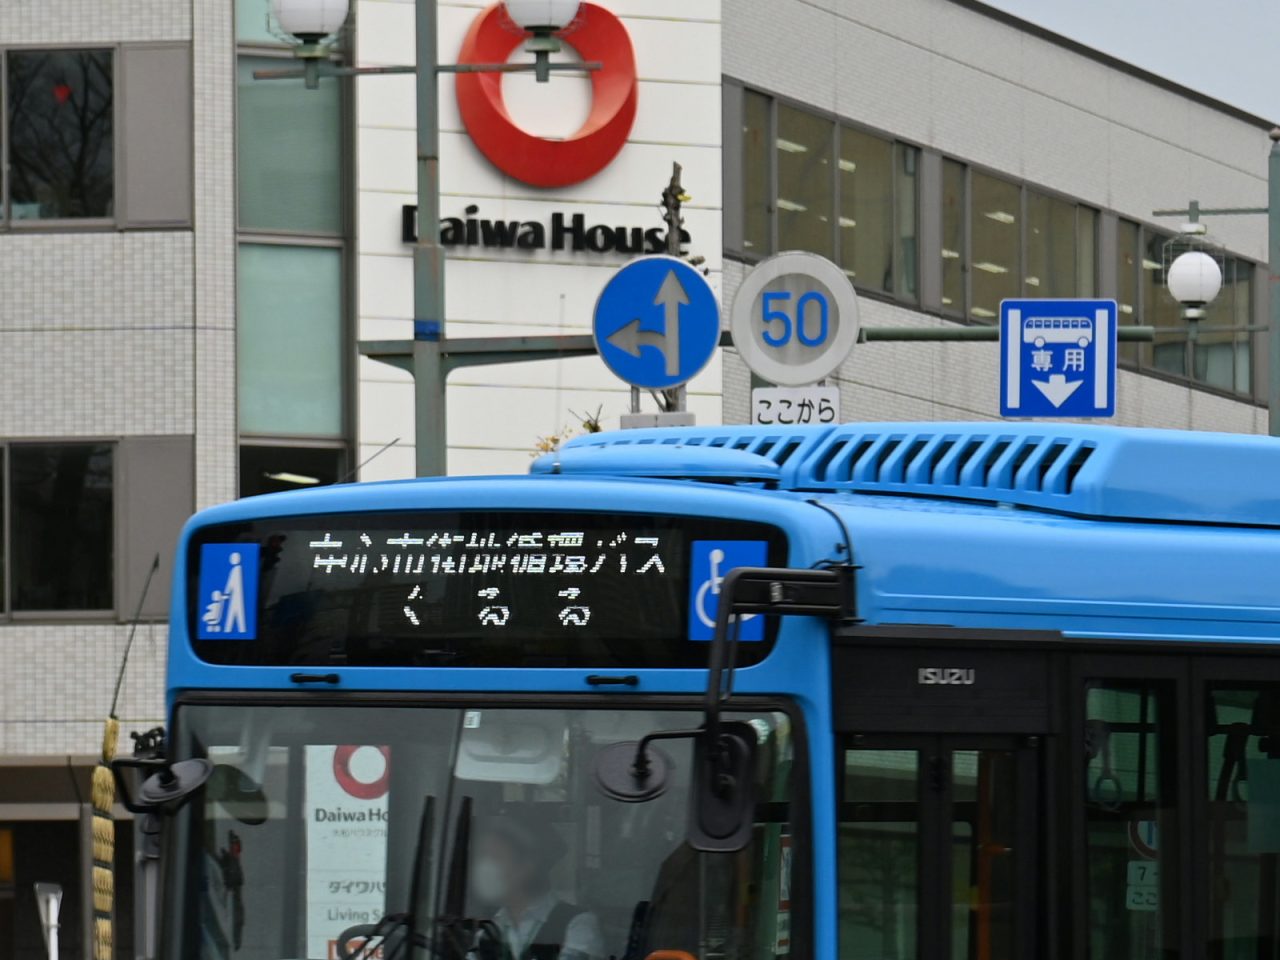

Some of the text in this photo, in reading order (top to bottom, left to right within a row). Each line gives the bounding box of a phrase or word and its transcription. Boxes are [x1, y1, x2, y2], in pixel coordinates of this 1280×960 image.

[761, 291, 829, 348] 50
[1030, 349, 1085, 372] 専用
[757, 398, 836, 425] ここから
[918, 668, 975, 684] ISUZU
[315, 808, 366, 822] Daiwa
